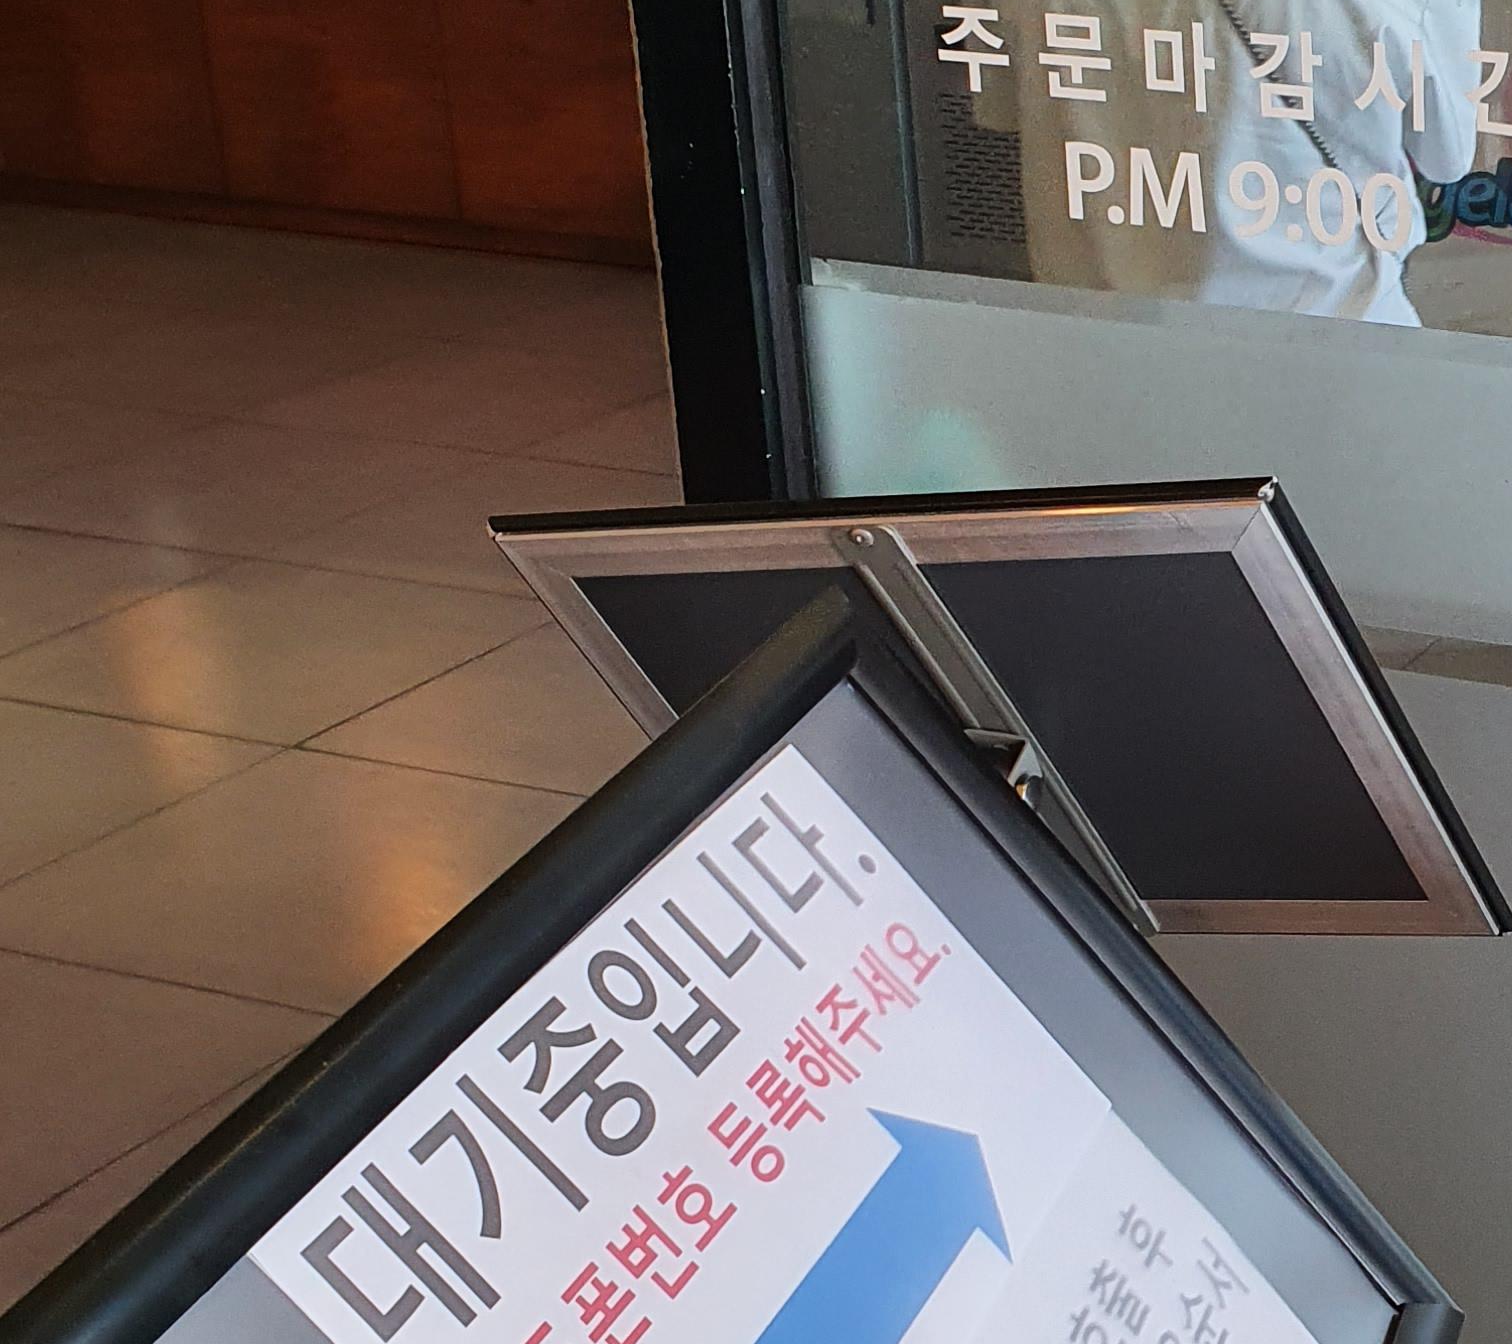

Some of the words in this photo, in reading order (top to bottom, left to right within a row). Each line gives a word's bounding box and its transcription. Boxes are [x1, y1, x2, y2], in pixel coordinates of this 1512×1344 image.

[1064, 141, 1206, 233] P.M
[1228, 160, 1414, 252] 9:00
[300, 790, 879, 1344] 대기중입니다.
[706, 922, 953, 1185] 등록해주세요.
[1117, 1202, 1174, 1270] 후
